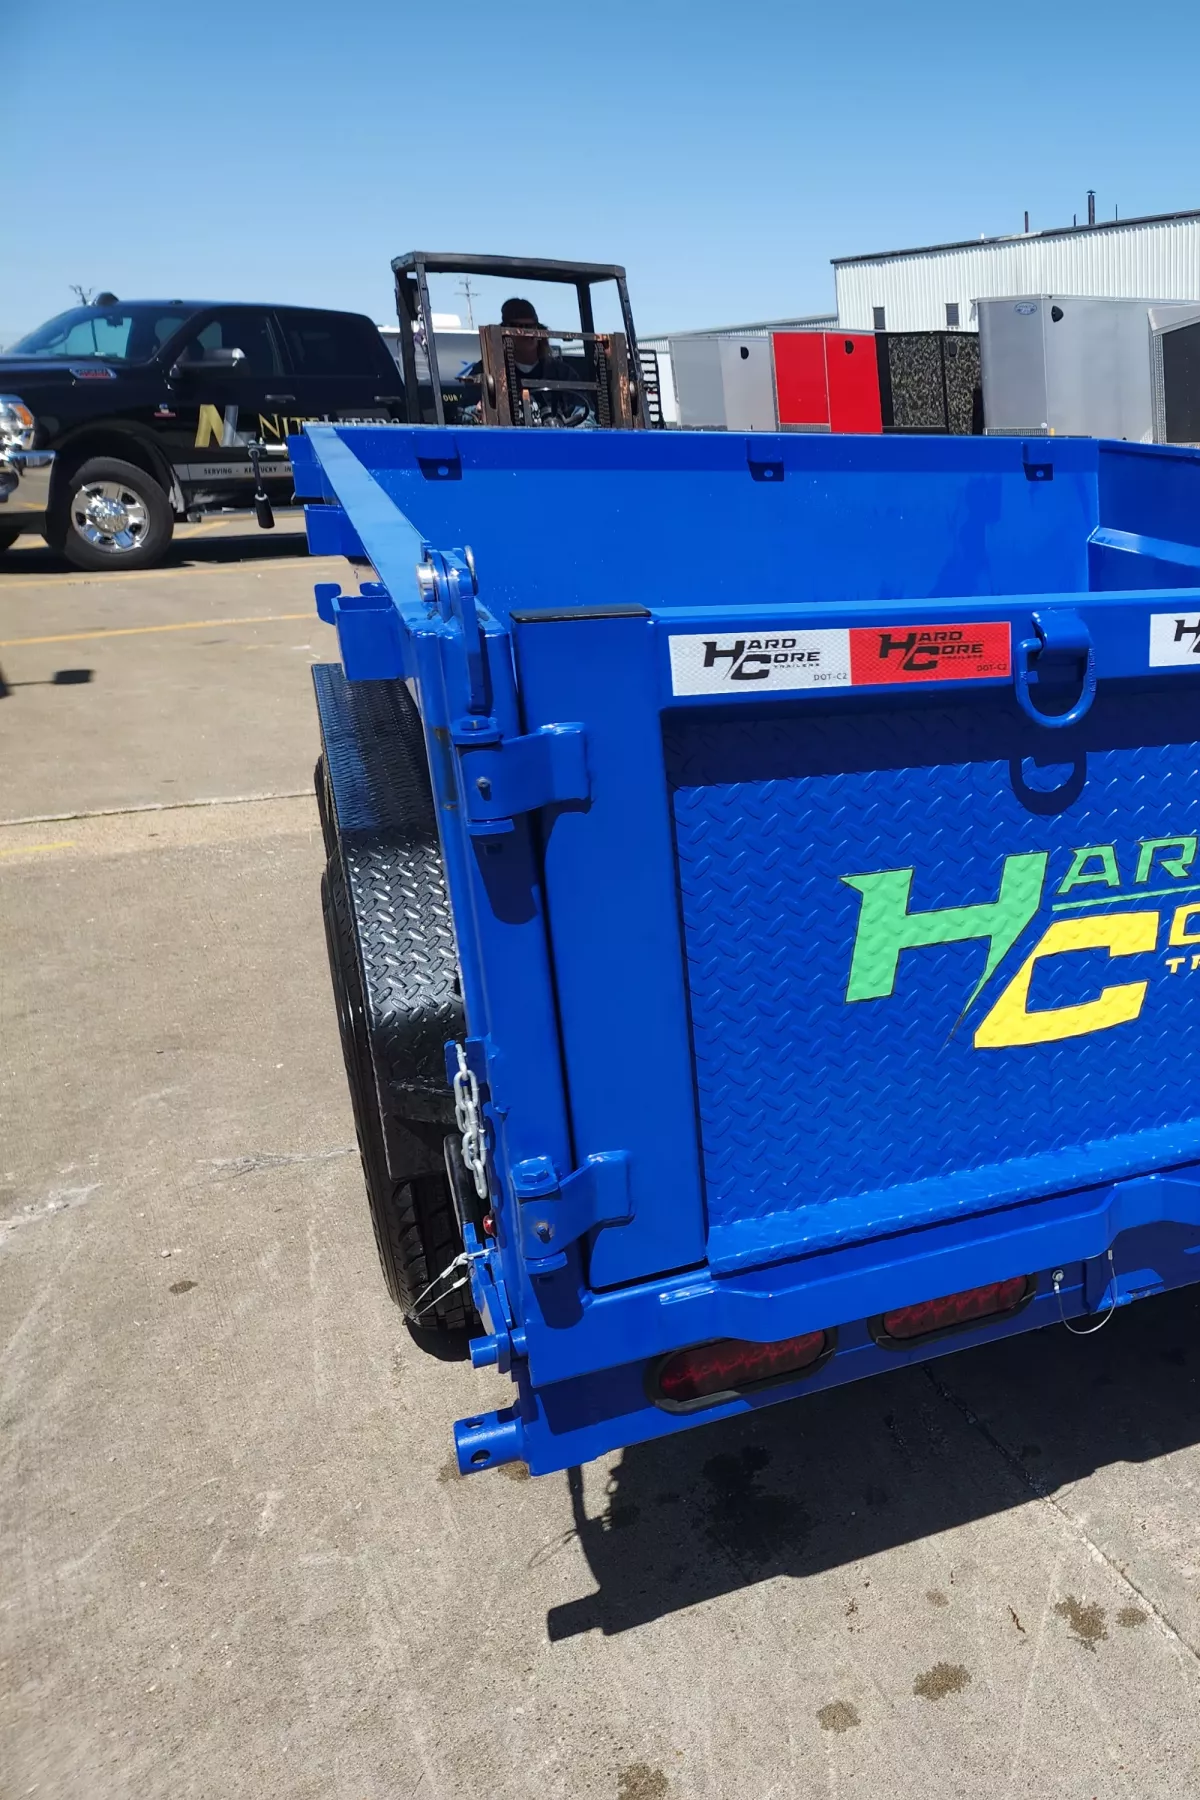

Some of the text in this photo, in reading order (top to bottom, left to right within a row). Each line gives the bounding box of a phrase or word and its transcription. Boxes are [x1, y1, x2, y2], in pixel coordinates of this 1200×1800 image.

[204, 467, 232, 475] SERVING
[702, 638, 797, 668] HARD
[878, 631, 963, 659] HARD
[903, 644, 984, 671] CORE
[731, 652, 820, 681] CORE
[813, 673, 848, 681] DOT-C2
[976, 664, 1007, 672] DOT-C2
